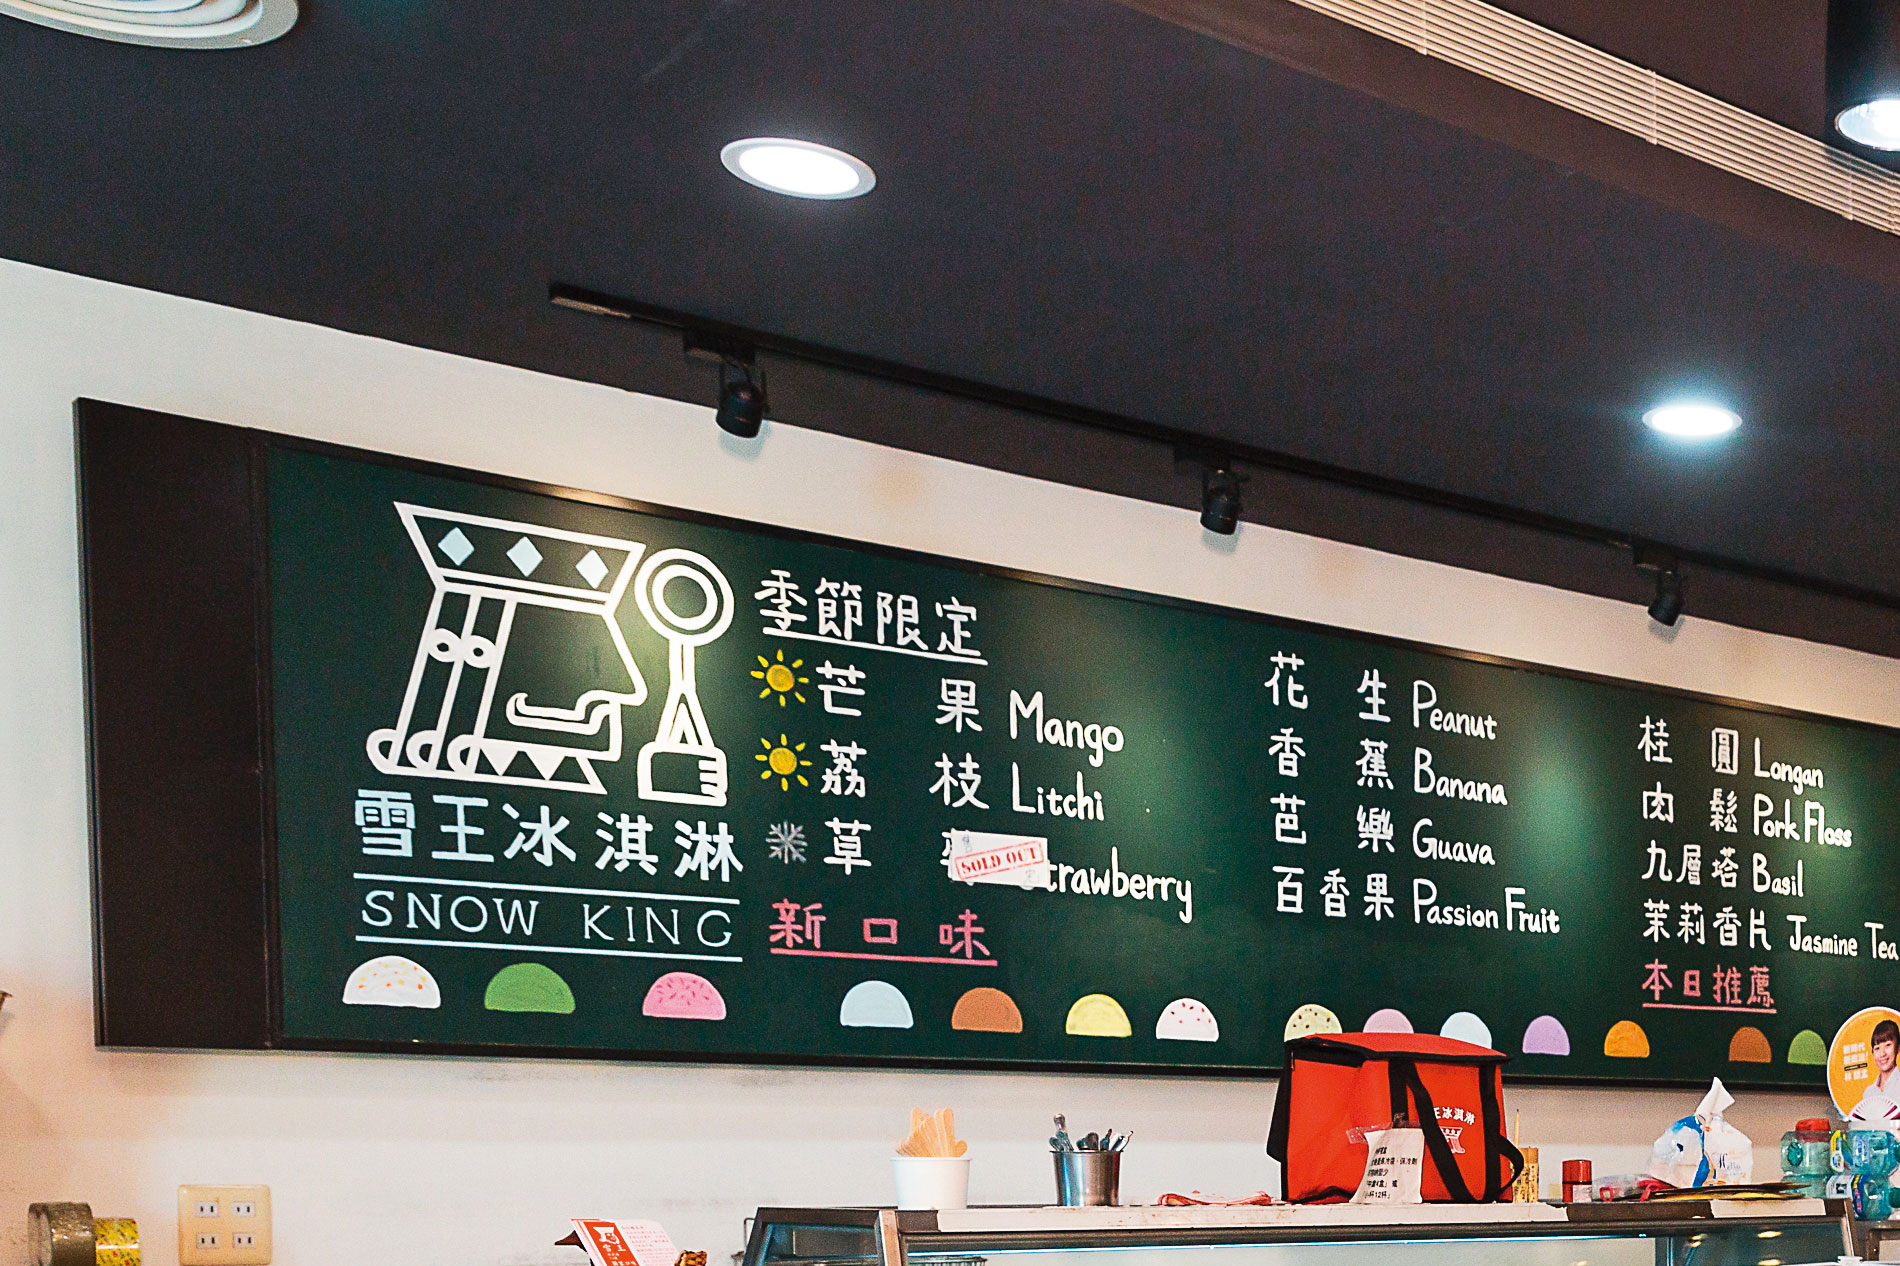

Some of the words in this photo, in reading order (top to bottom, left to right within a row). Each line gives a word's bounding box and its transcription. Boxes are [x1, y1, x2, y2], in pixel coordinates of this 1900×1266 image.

[754, 569, 979, 653] 季節限定
[1009, 689, 1125, 767] Mango
[1412, 679, 1498, 741] Peanut
[1011, 771, 1105, 822] Litchi
[1413, 746, 1508, 806] Banana
[1754, 738, 1824, 796] Longan
[354, 789, 744, 883] 雪王冰淇淋
[1412, 817, 1496, 866] Guava
[1753, 796, 1799, 841] Pork
[1804, 800, 1852, 848] Floss
[961, 854, 1002, 874] SOLD
[1006, 847, 1037, 864] OUT
[1020, 846, 1193, 924] trawberry
[1641, 839, 1739, 888] 九層塔
[1752, 852, 1804, 898] Basil
[361, 890, 539, 937] SNOW
[583, 902, 733, 947] KING
[769, 898, 991, 957] 新口味
[1272, 865, 1395, 922] 百香果
[1412, 878, 1499, 930] Passion
[1504, 886, 1561, 934] Fruit
[1642, 898, 1772, 951] 茉莉香片
[1786, 914, 1858, 957] Jasmine
[1863, 921, 1900, 961] Tea
[1641, 958, 1774, 1006] 本日推薦
